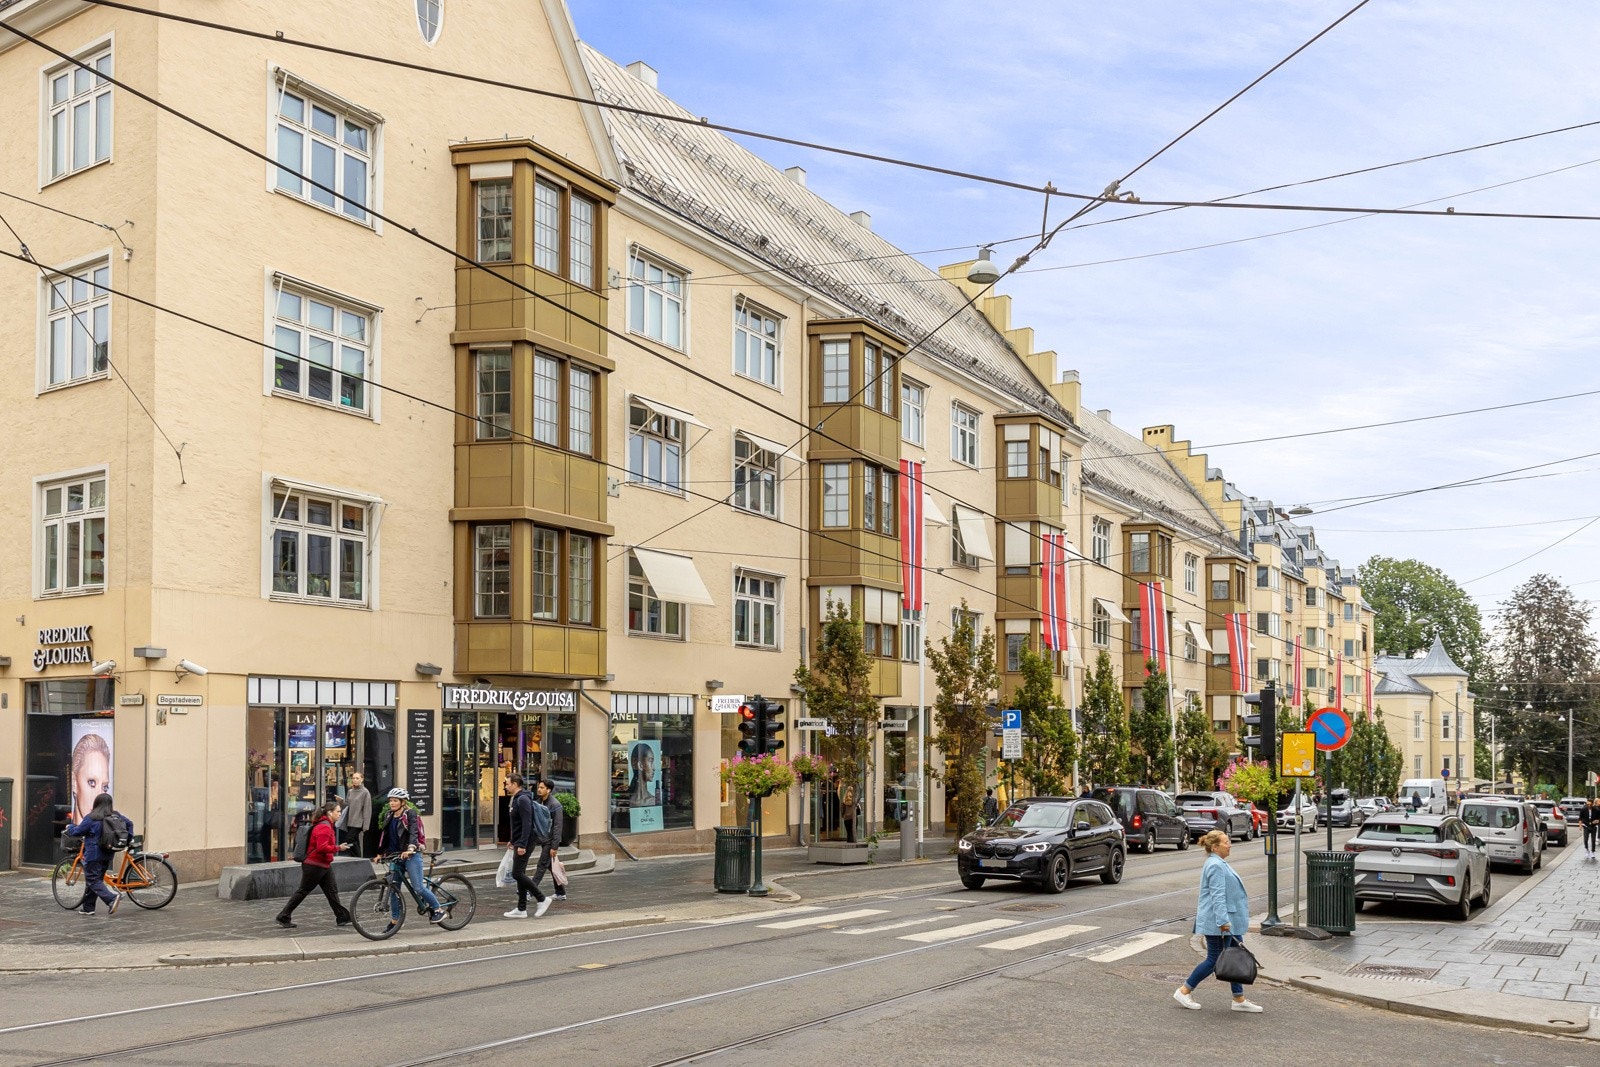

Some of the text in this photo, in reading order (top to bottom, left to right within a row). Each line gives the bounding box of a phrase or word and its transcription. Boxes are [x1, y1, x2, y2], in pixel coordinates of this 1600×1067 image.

[38, 624, 91, 645] FREDRIK
[32, 646, 91, 672] &LOUISA
[160, 696, 201, 705] Bogstadveien
[523, 714, 541, 722] Dior
[611, 712, 638, 721] ANEL
[1006, 712, 1017, 727] P
